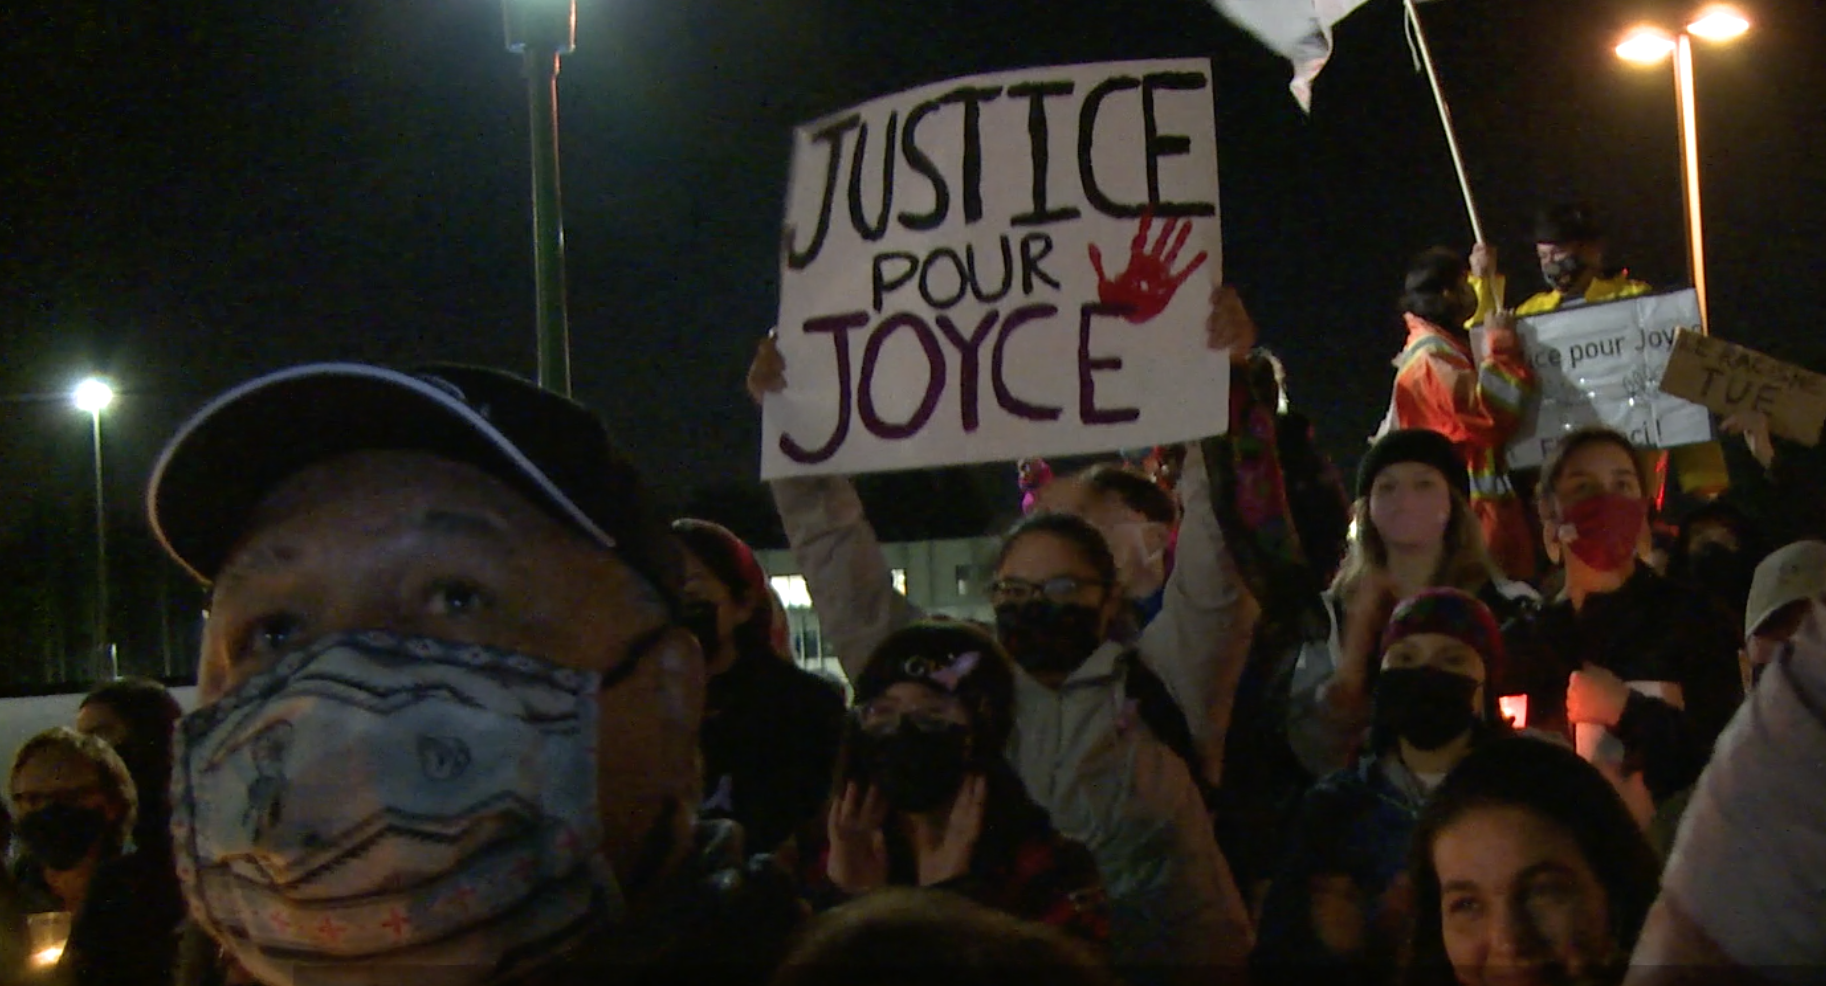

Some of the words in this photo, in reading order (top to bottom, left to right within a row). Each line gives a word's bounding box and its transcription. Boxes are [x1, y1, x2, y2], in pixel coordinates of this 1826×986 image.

[785, 71, 1215, 269] JUSTICE
[872, 232, 1061, 312] POUR
[779, 303, 1141, 464] JOYCE
[1569, 334, 1626, 369] pour
[1700, 367, 1782, 415] TUE
